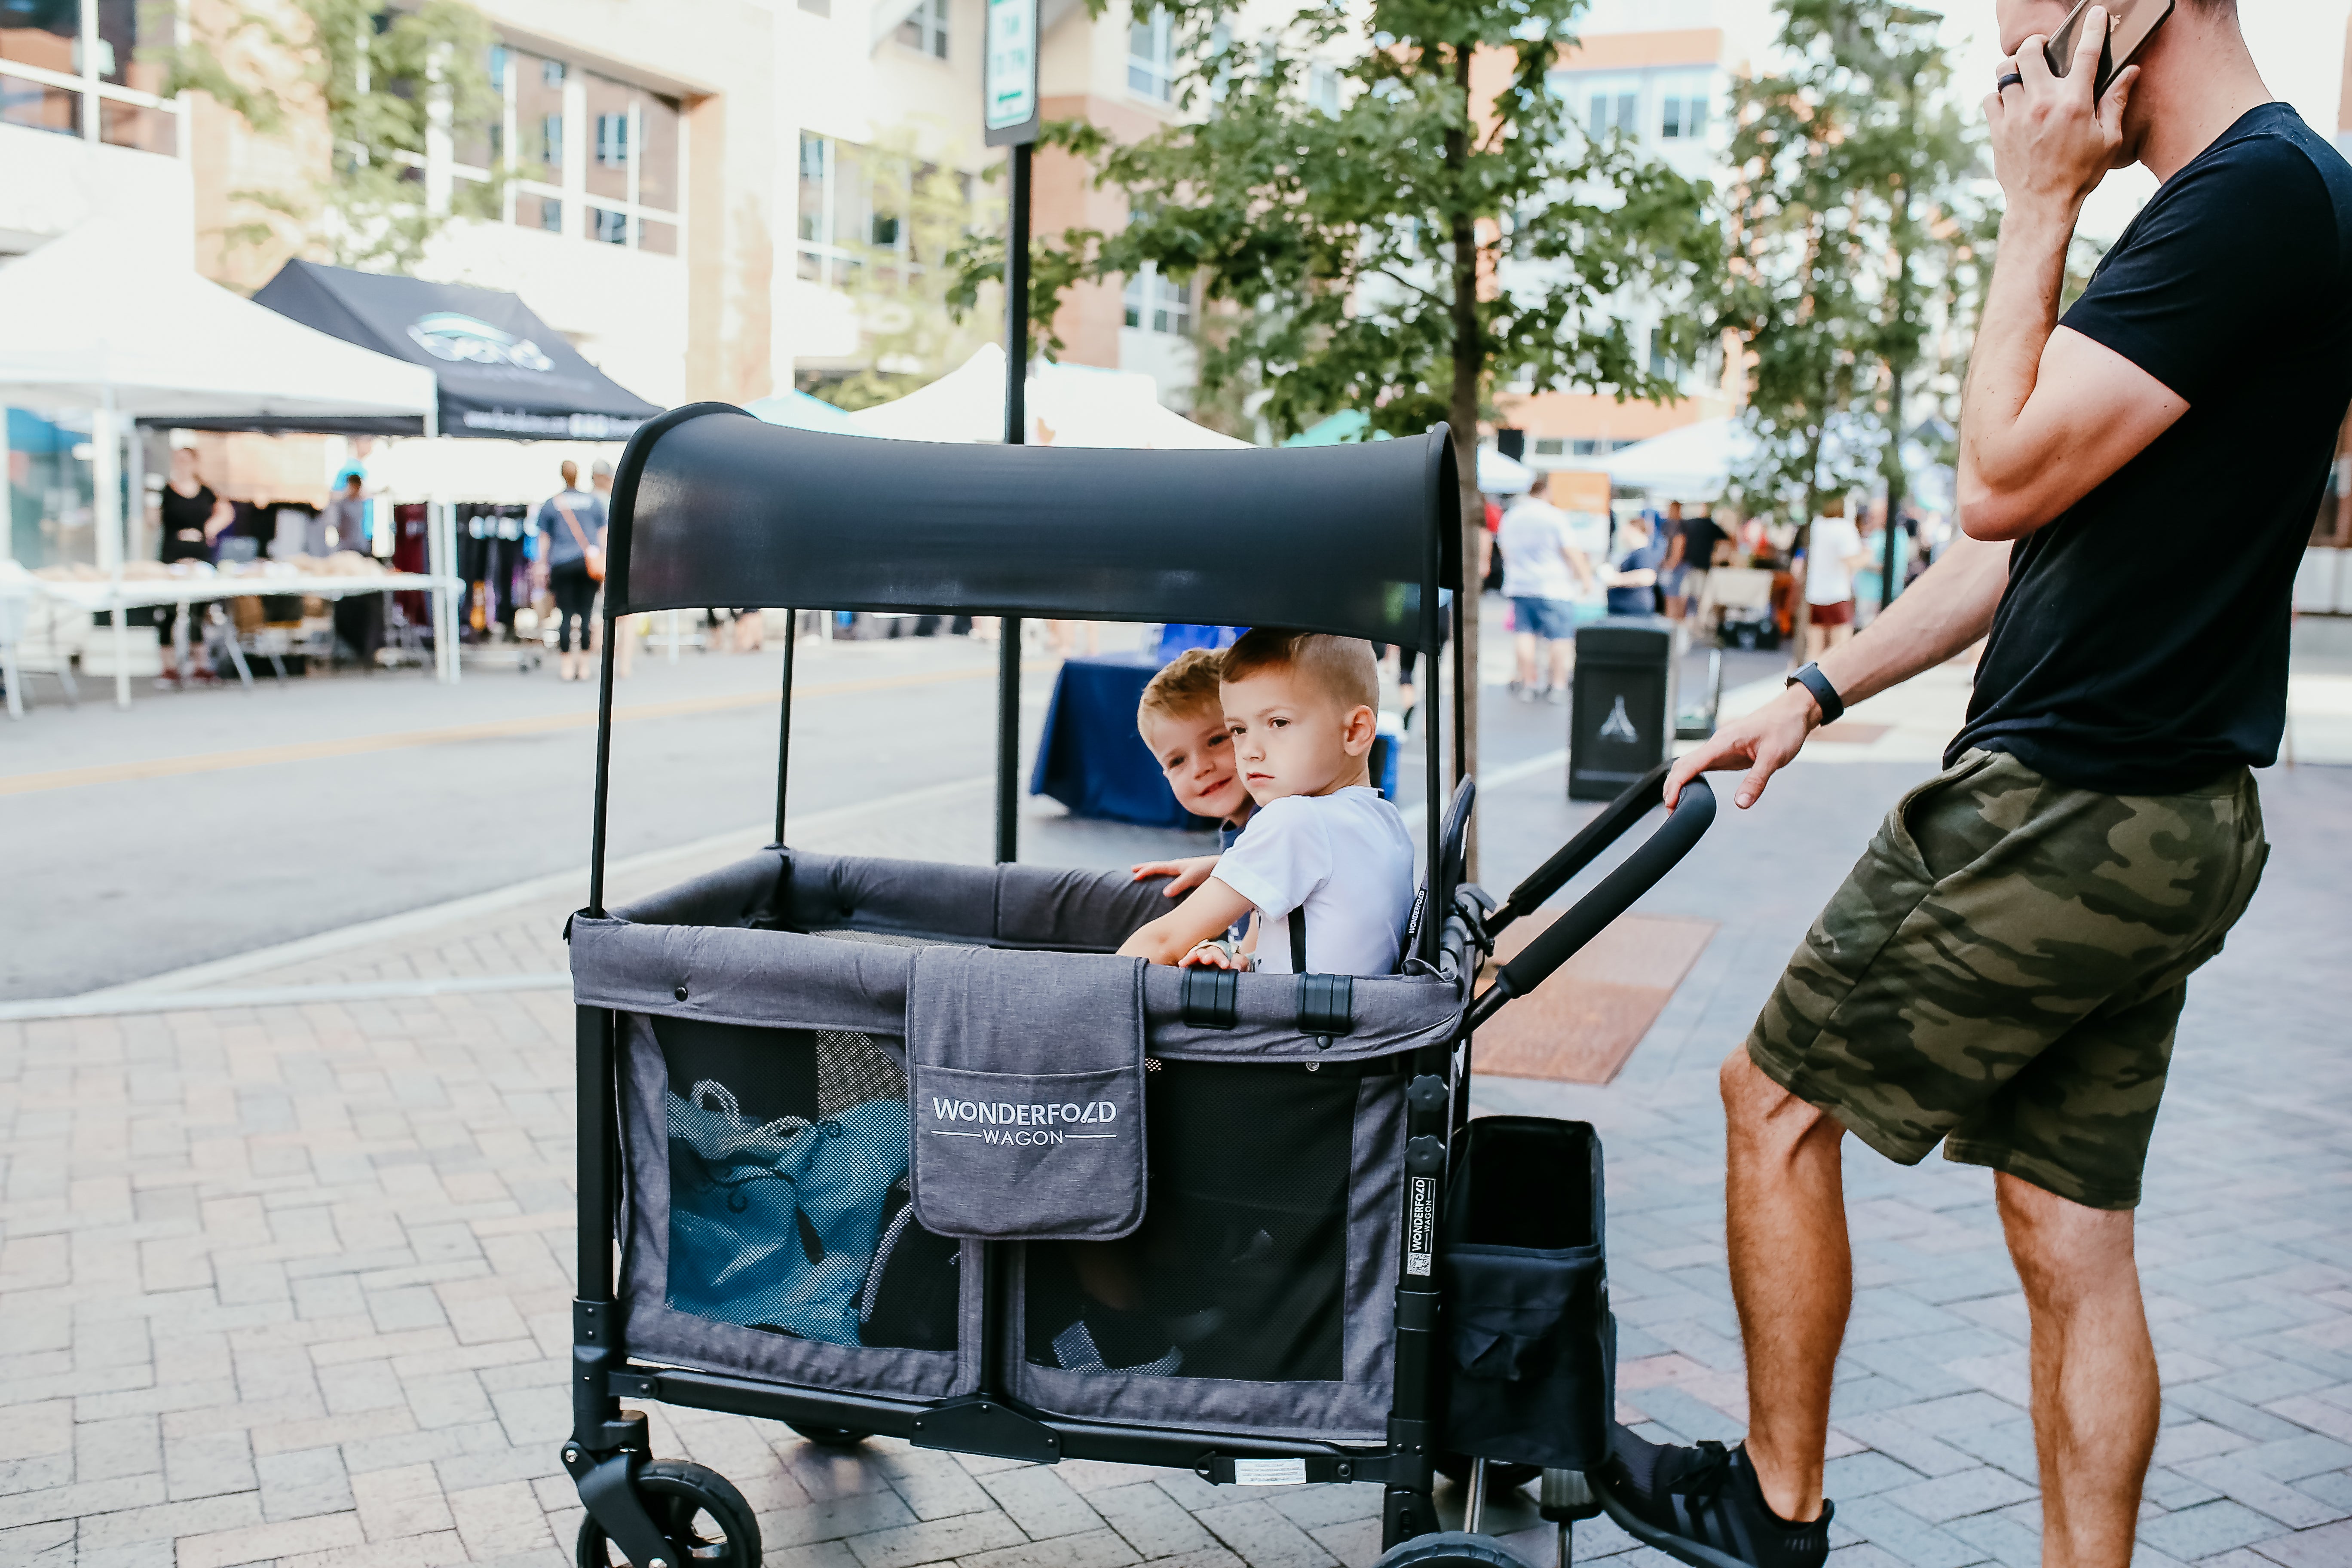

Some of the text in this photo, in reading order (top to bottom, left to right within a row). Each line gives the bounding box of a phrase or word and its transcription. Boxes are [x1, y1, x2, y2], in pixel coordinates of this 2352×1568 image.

[1409, 890, 1424, 933] WONDERFOLD
[932, 1097, 1117, 1125] WONDERFOLD
[983, 1129, 1063, 1146] WAGON
[1412, 1179, 1425, 1251] WONDERFOLD
